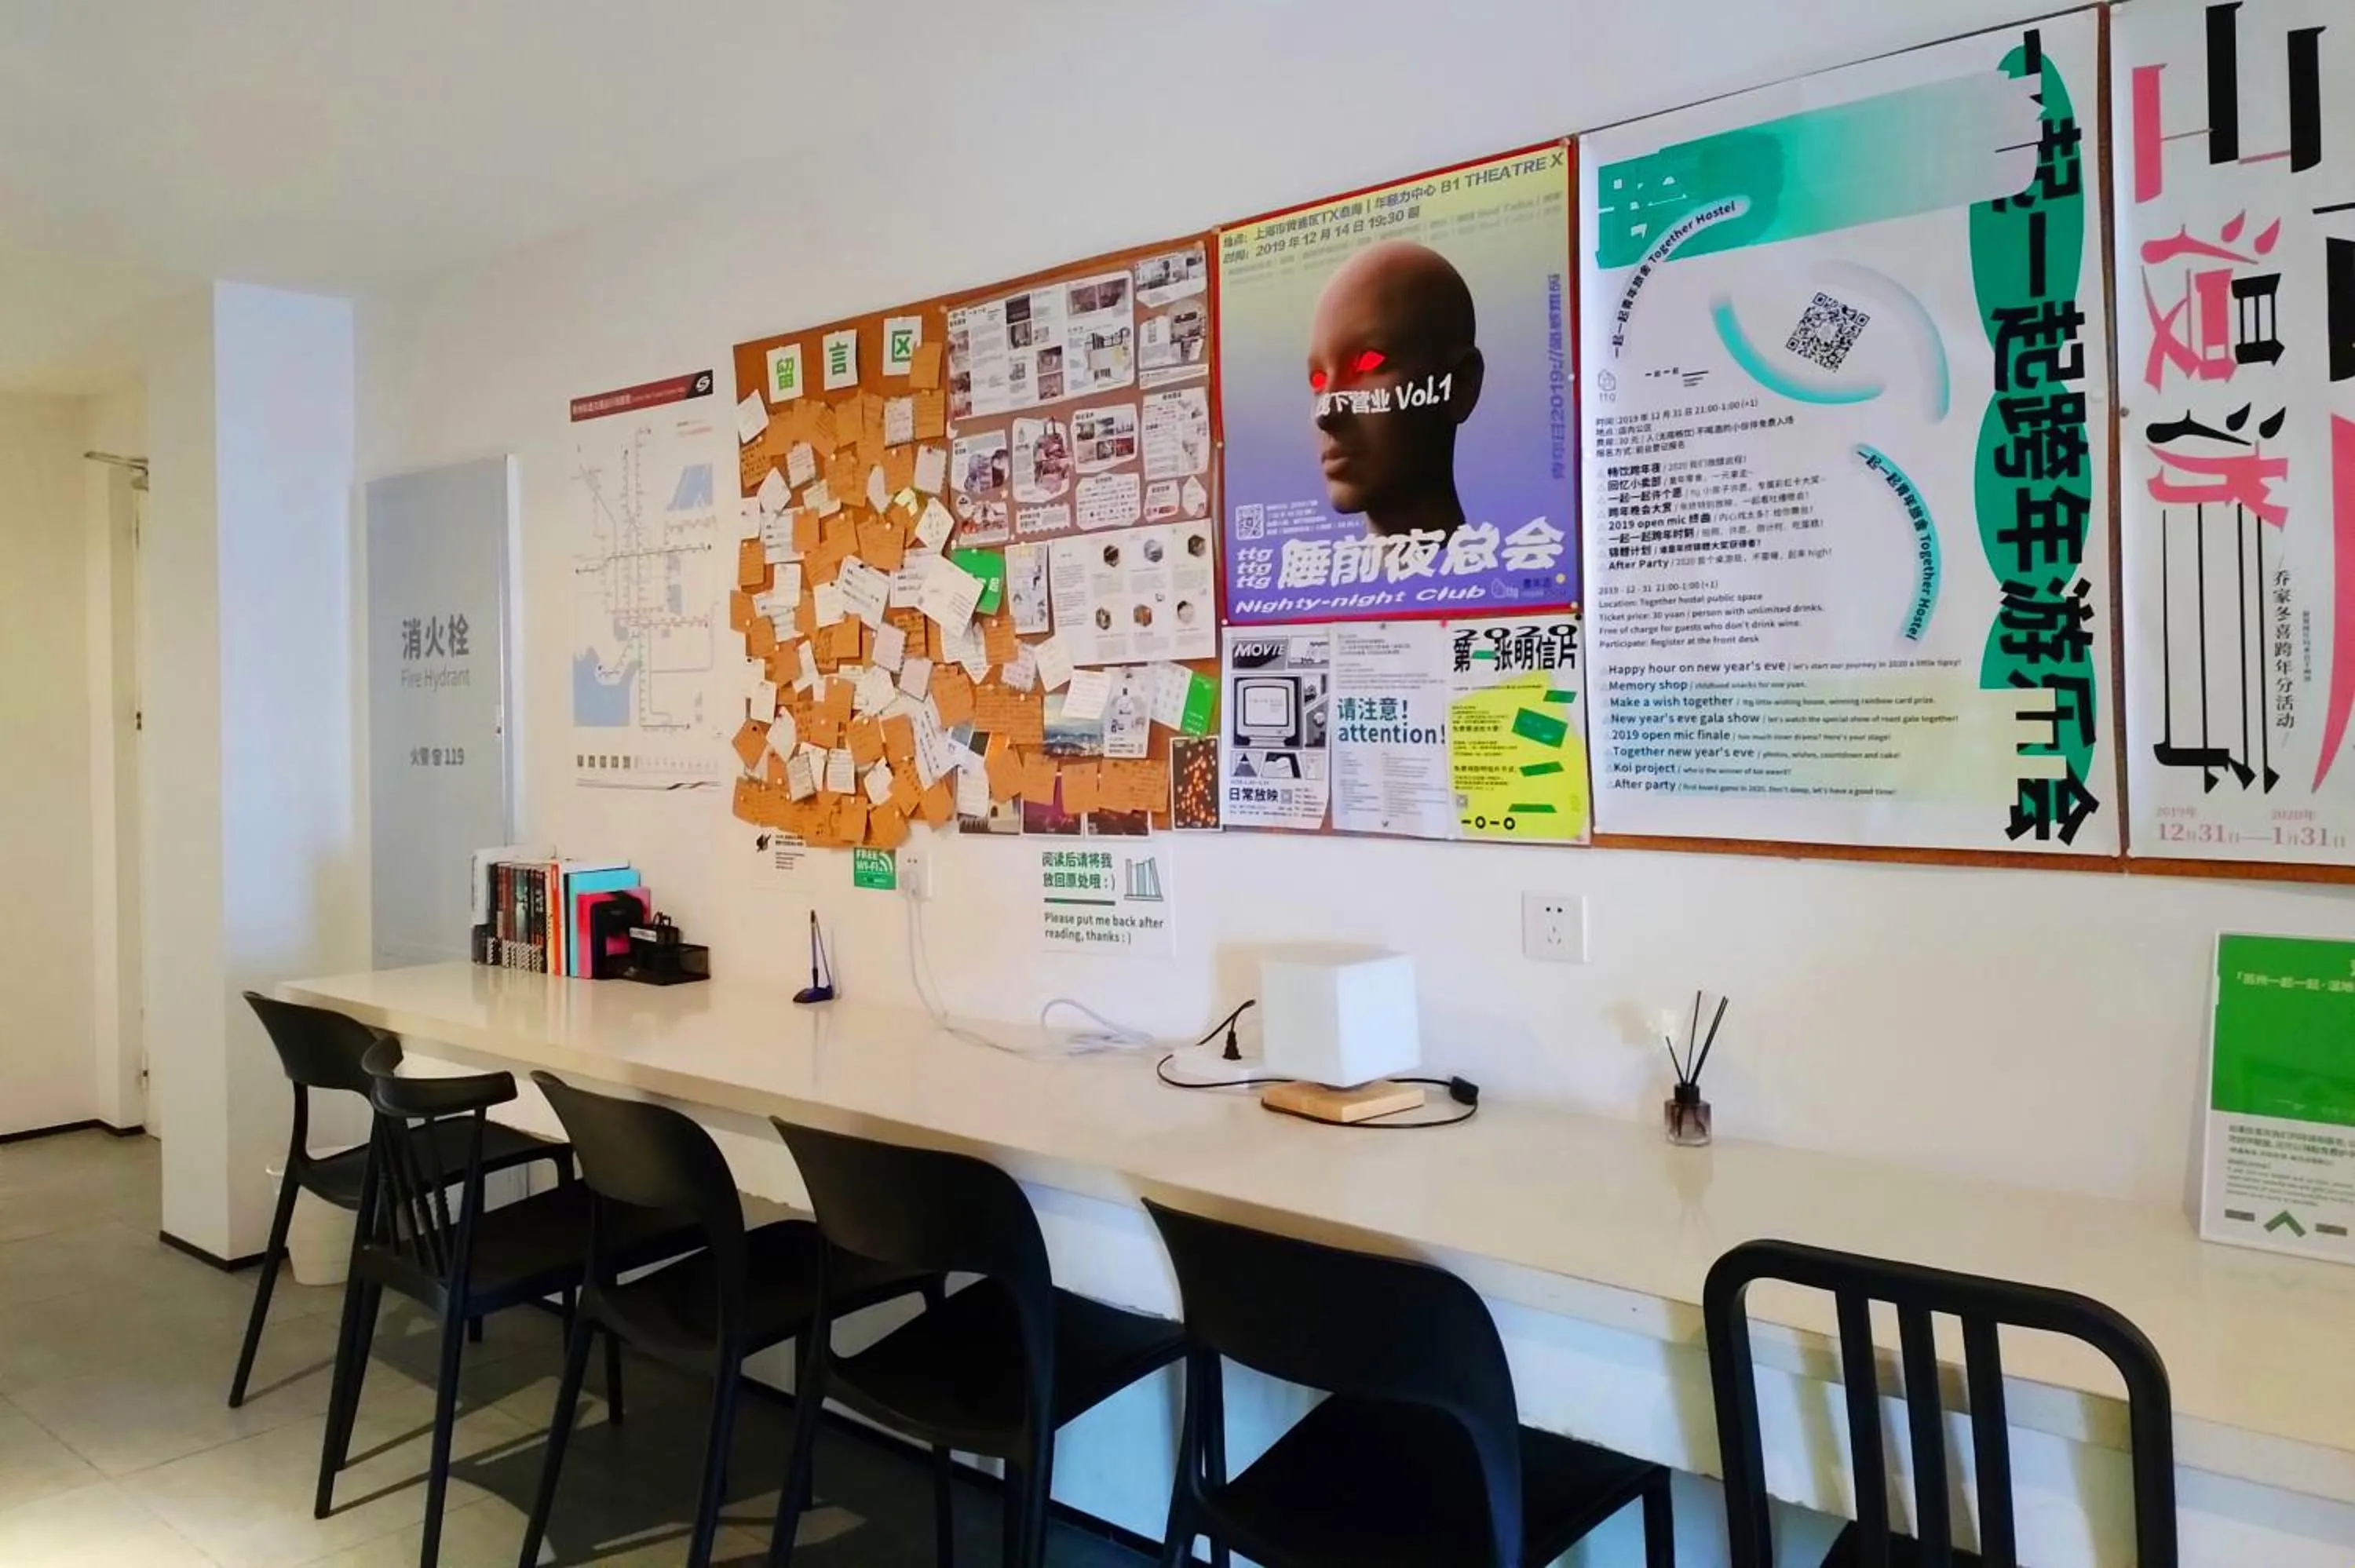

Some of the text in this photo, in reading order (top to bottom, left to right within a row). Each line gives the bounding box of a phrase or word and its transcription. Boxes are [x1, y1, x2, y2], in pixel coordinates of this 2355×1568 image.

[1440, 178, 1460, 195] B1
[1464, 158, 1546, 188] THEATRE
[1549, 152, 1565, 168] X
[1256, 210, 1404, 257] 2019 年 12 月 14 日 19:30
[1648, 201, 1736, 263] Together Hostel
[1395, 373, 1453, 410] Vol.1
[1618, 414, 1638, 425] 2019
[1651, 412, 1661, 421] 12
[1673, 407, 1683, 418] 31
[1608, 515, 1686, 531] 2019 open mic
[1277, 516, 1566, 590] 睡前夜总会
[1608, 557, 1670, 571] After Party
[1905, 534, 1935, 641] Together Hostel
[1235, 587, 1486, 614] Nighty-night Club
[1640, 597, 1677, 607] Together
[1707, 593, 1735, 603] public
[1599, 613, 1625, 622] Ticket
[1663, 611, 1685, 621] yuan
[1692, 608, 1722, 618] person
[1725, 607, 1744, 616] with
[1747, 604, 1791, 614] unlimited
[1453, 624, 1578, 641] 2020
[1630, 625, 1659, 635] charge
[1674, 623, 1703, 633] guests
[1751, 618, 1775, 629] drink
[401, 614, 470, 661] 消火栓
[1650, 637, 1685, 648] Register
[1697, 636, 1711, 644] the
[1713, 635, 1736, 644] front
[1738, 634, 1759, 644] desk
[1234, 643, 1286, 658] MOVIE
[1453, 636, 1578, 673] 第一张明信片
[1609, 665, 1645, 676] Happy
[1648, 663, 1676, 673] hour
[1679, 664, 1694, 673] on
[1697, 662, 1721, 672] new
[1725, 661, 1761, 675] year's
[1765, 662, 1785, 671] eve
[400, 665, 471, 692] Fire Hydrant
[1609, 680, 1688, 691] Memory shop
[1610, 697, 1640, 707] Make
[1652, 695, 1680, 706] wish
[1683, 695, 1734, 709] together
[1611, 713, 1636, 724] New
[1638, 713, 1674, 725] year's
[1700, 713, 1725, 726] gala
[1727, 712, 1760, 722] show
[1338, 722, 1446, 745] attention!
[1612, 729, 1639, 740] 2019
[1641, 731, 1671, 741] open
[1674, 730, 1695, 740] mic
[1697, 729, 1731, 740] finale
[444, 747, 465, 767] 119
[1613, 746, 1665, 759] Together
[1667, 748, 1692, 757] new
[1695, 746, 1732, 760] year's
[1732, 749, 1755, 757] eve
[1614, 762, 1676, 775] Koi project
[1615, 779, 1642, 789] After
[1645, 780, 1676, 792] party
[1229, 788, 1278, 802] 日常放映
[856, 848, 878, 860] FREE
[1042, 851, 1113, 869] 阅读后请将我
[1044, 912, 1163, 928] Please put me back after
[1045, 929, 1119, 943] reading, thanks
